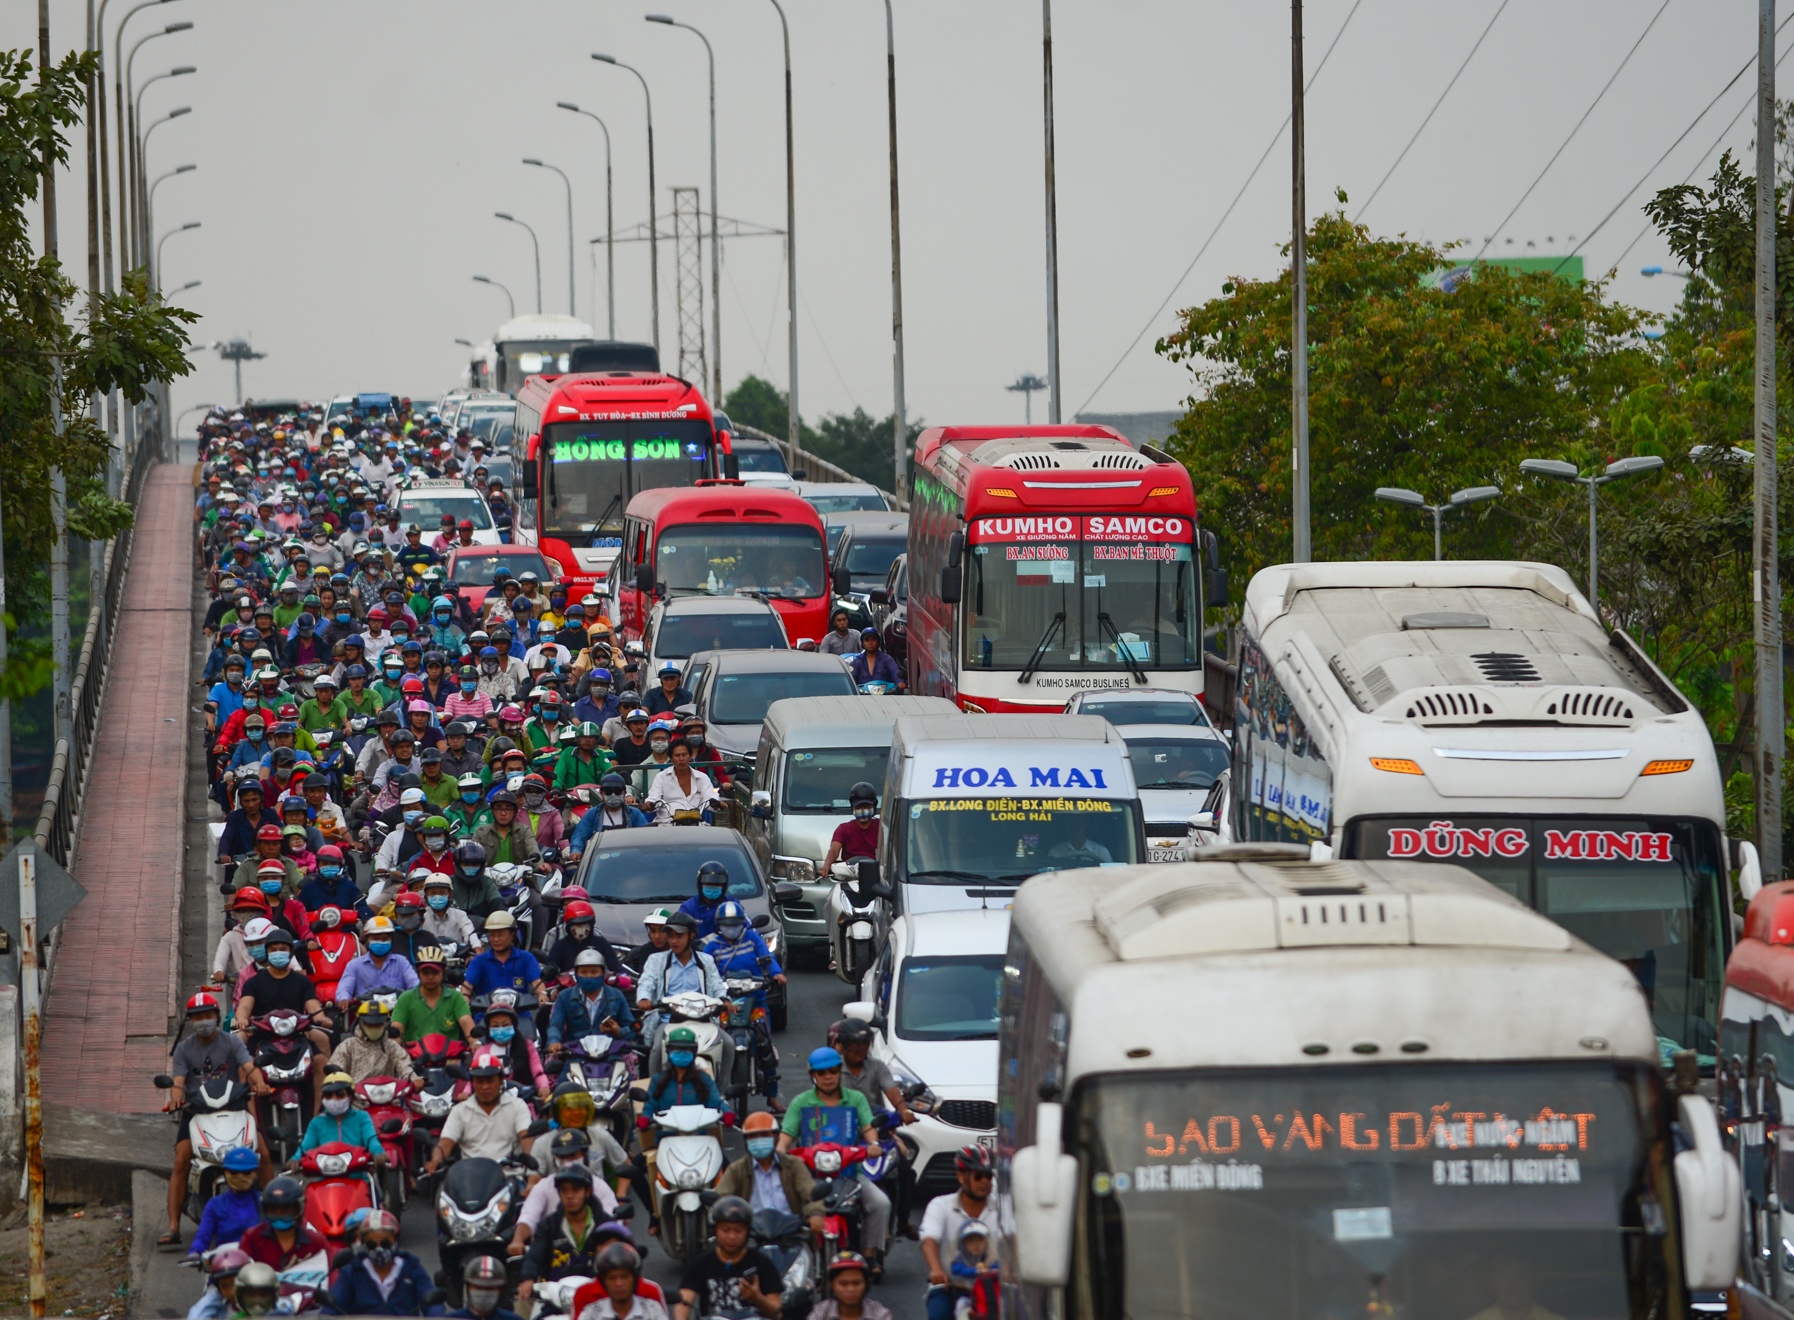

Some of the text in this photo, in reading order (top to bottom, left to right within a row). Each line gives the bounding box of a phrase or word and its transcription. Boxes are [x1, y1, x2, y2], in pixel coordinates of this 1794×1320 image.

[642, 411, 660, 419] BÌNH
[554, 435, 680, 460] HỒNG SƠN
[978, 517, 1183, 536] KUMHO SAMCO
[1130, 542, 1145, 560] MÊ
[1146, 543, 1178, 565] THUỘT
[1036, 678, 1130, 688] KUMHO SAMCO BUSLINES
[932, 766, 1108, 789] HOA MAI
[1076, 798, 1112, 812] ĐÔNG
[990, 812, 1026, 821] LONG
[1387, 820, 1674, 862] DŨNG MINH
